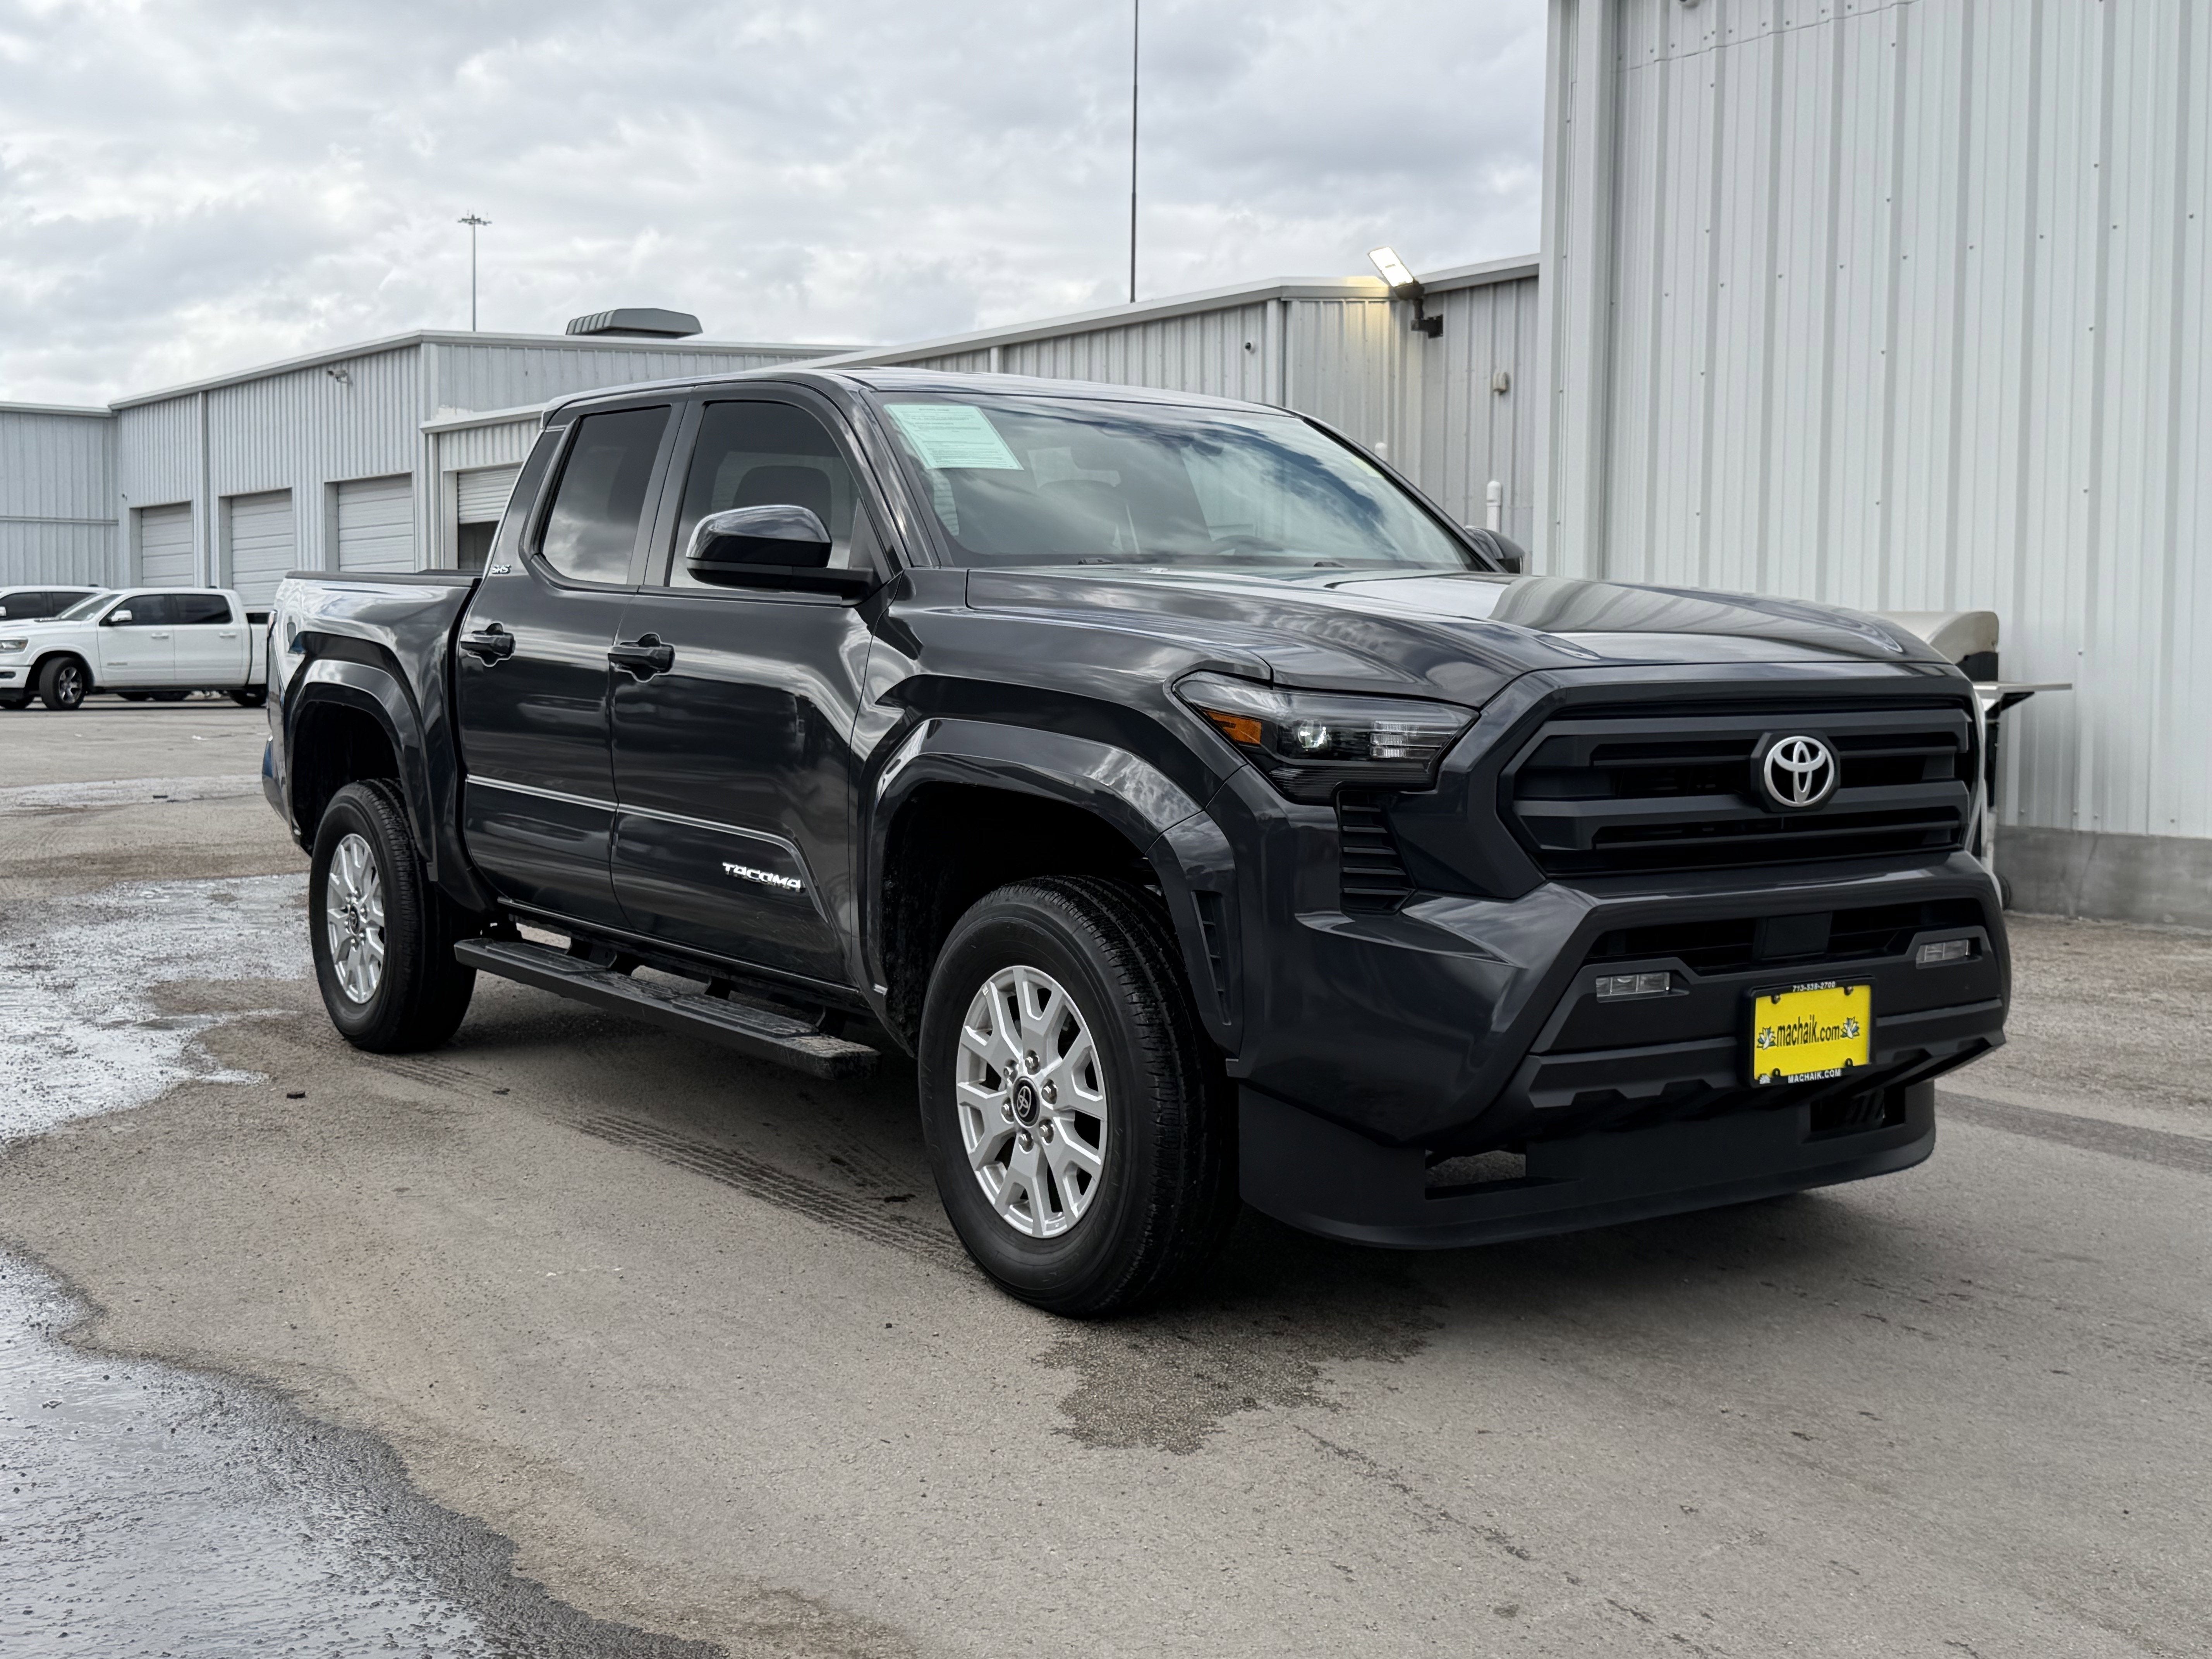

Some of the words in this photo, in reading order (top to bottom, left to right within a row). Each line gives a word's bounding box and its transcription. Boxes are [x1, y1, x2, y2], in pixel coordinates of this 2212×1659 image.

[722, 862, 801, 890] TACOMA
[1777, 1014, 1840, 1047] machaik.com
[1788, 1068, 1841, 1084] MACHAIK.COM
